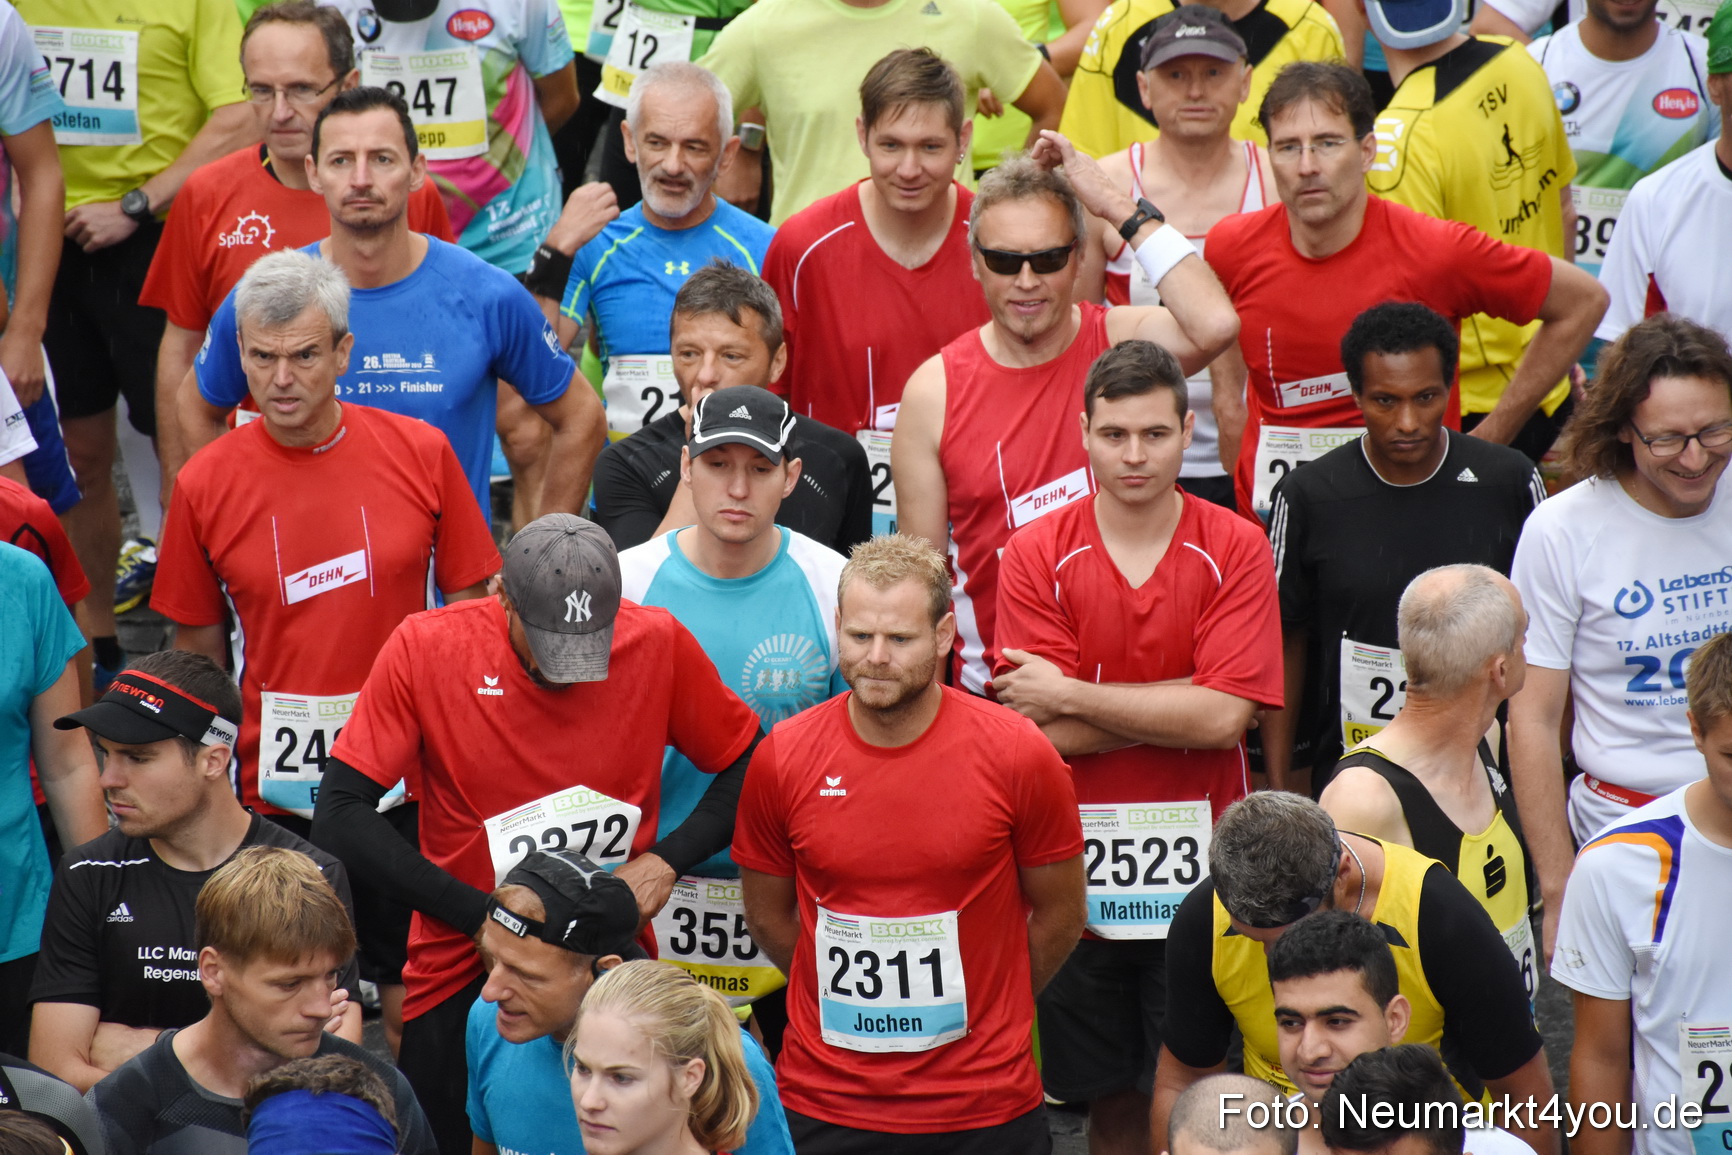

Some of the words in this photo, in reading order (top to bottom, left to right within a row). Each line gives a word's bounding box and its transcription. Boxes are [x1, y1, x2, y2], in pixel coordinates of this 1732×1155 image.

[452, 17, 490, 34] Hervis
[71, 32, 125, 49] BOCK
[1478, 83, 1508, 119] TSV
[1659, 96, 1697, 112] Hervis
[53, 111, 101, 129] Stefan
[417, 131, 446, 147] epp
[219, 232, 254, 248] Spitz
[363, 356, 381, 369] 26.
[358, 382, 371, 394] 21
[400, 381, 444, 393] Finisher
[1301, 382, 1332, 397] DEHN
[729, 412, 752, 420] adidas
[1266, 441, 1303, 450] NeuerMarkt
[1269, 458, 1312, 503] 2
[1034, 485, 1067, 510] DEHN
[309, 566, 343, 588] DEHN
[1617, 640, 1640, 651] 17.
[1352, 656, 1393, 669] NeuerMarkt
[477, 687, 504, 696] erima
[139, 700, 161, 714] running
[272, 708, 311, 719] NeuerMarkt
[275, 726, 343, 774] 24
[820, 788, 846, 797] erima
[1605, 791, 1629, 804] balance
[500, 811, 546, 834] NeuerMarkt
[1128, 807, 1199, 825] BOCK
[1081, 820, 1119, 829] euerMarkt
[1084, 836, 1201, 888] 2523
[106, 915, 134, 923] adidas
[824, 925, 863, 939] NeuerMarkt
[870, 919, 946, 938] BOCK
[138, 947, 164, 960] LLC
[168, 947, 198, 961] Mar
[683, 967, 749, 992] homas
[828, 945, 944, 1000] 2311
[823, 989, 829, 997] A
[854, 1013, 923, 1033] Jochen
[1698, 1060, 1732, 1115] 2
